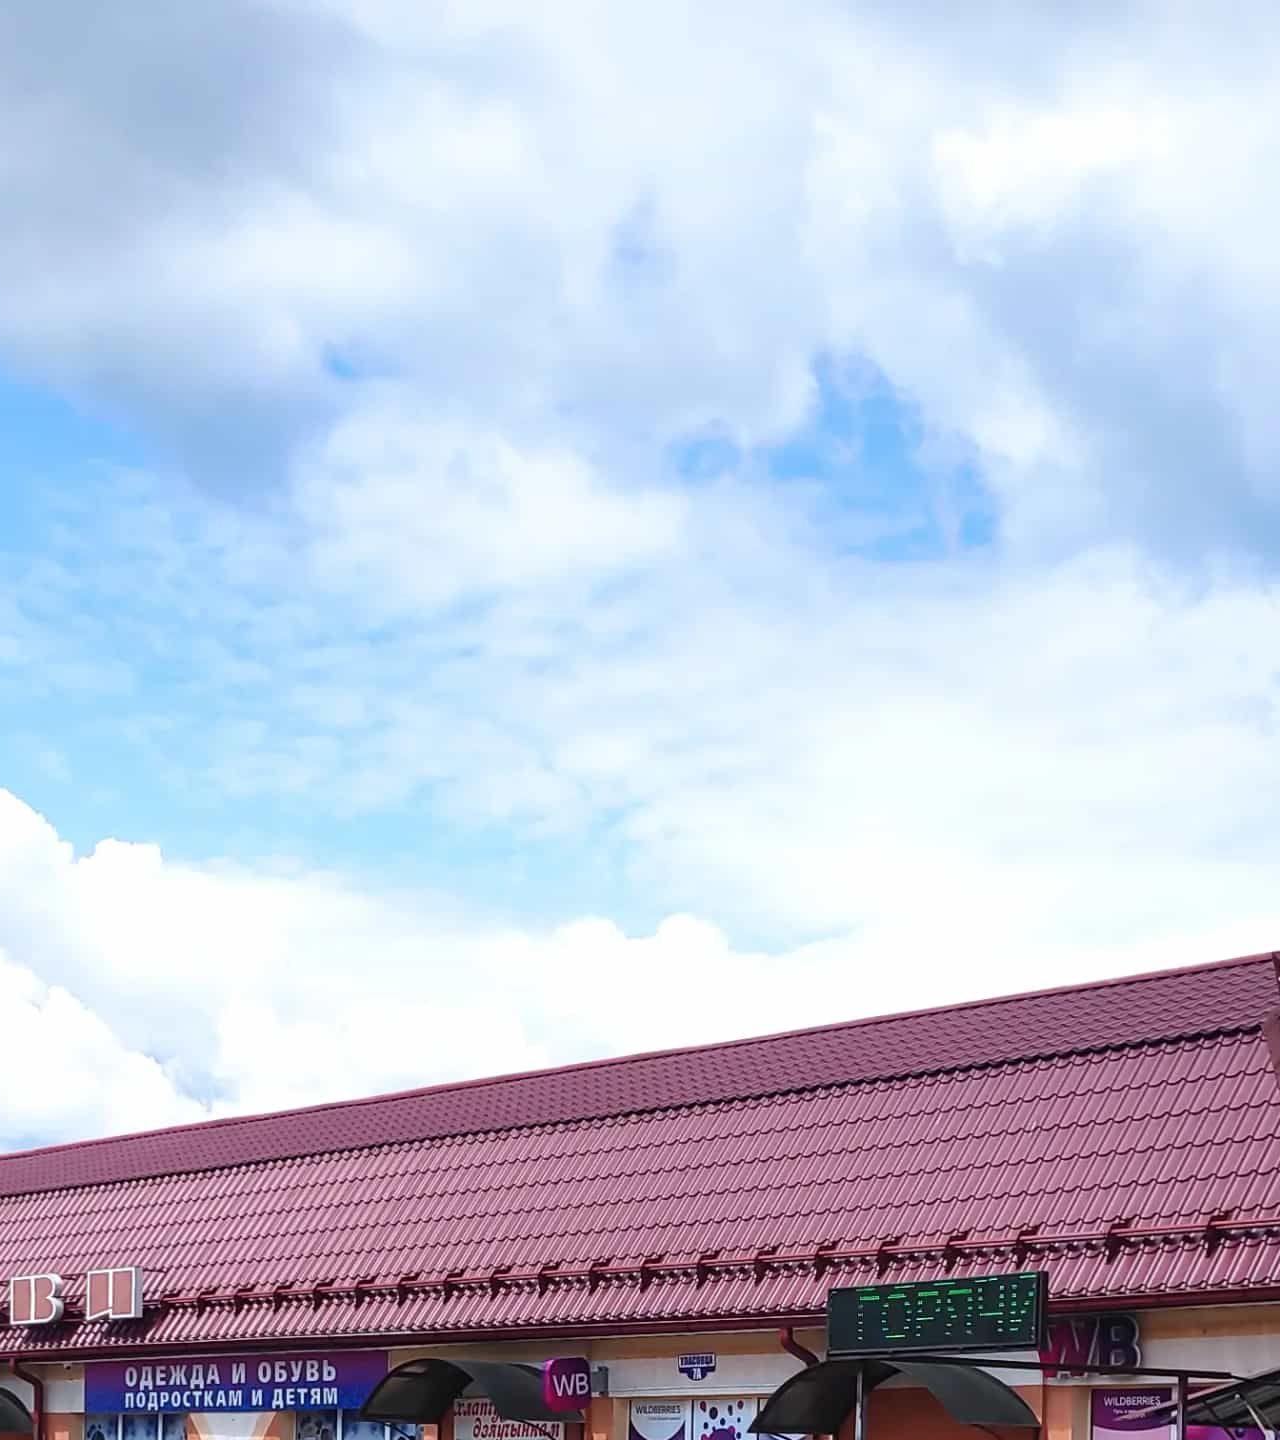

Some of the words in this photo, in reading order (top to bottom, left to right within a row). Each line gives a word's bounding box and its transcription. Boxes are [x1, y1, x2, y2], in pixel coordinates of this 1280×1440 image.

[1038, 1312, 1142, 1377] WB
[124, 1364, 220, 1391] ОДЕЖДА
[231, 1363, 246, 1385] И
[258, 1360, 337, 1384] ОБУВЬ
[552, 1373, 589, 1397] WB
[124, 1389, 243, 1410] ПОДРОСТКАМ
[251, 1388, 263, 1406] И
[271, 1386, 338, 1409] ДЕТЯМ
[1104, 1396, 1161, 1407] WILDBERRIES
